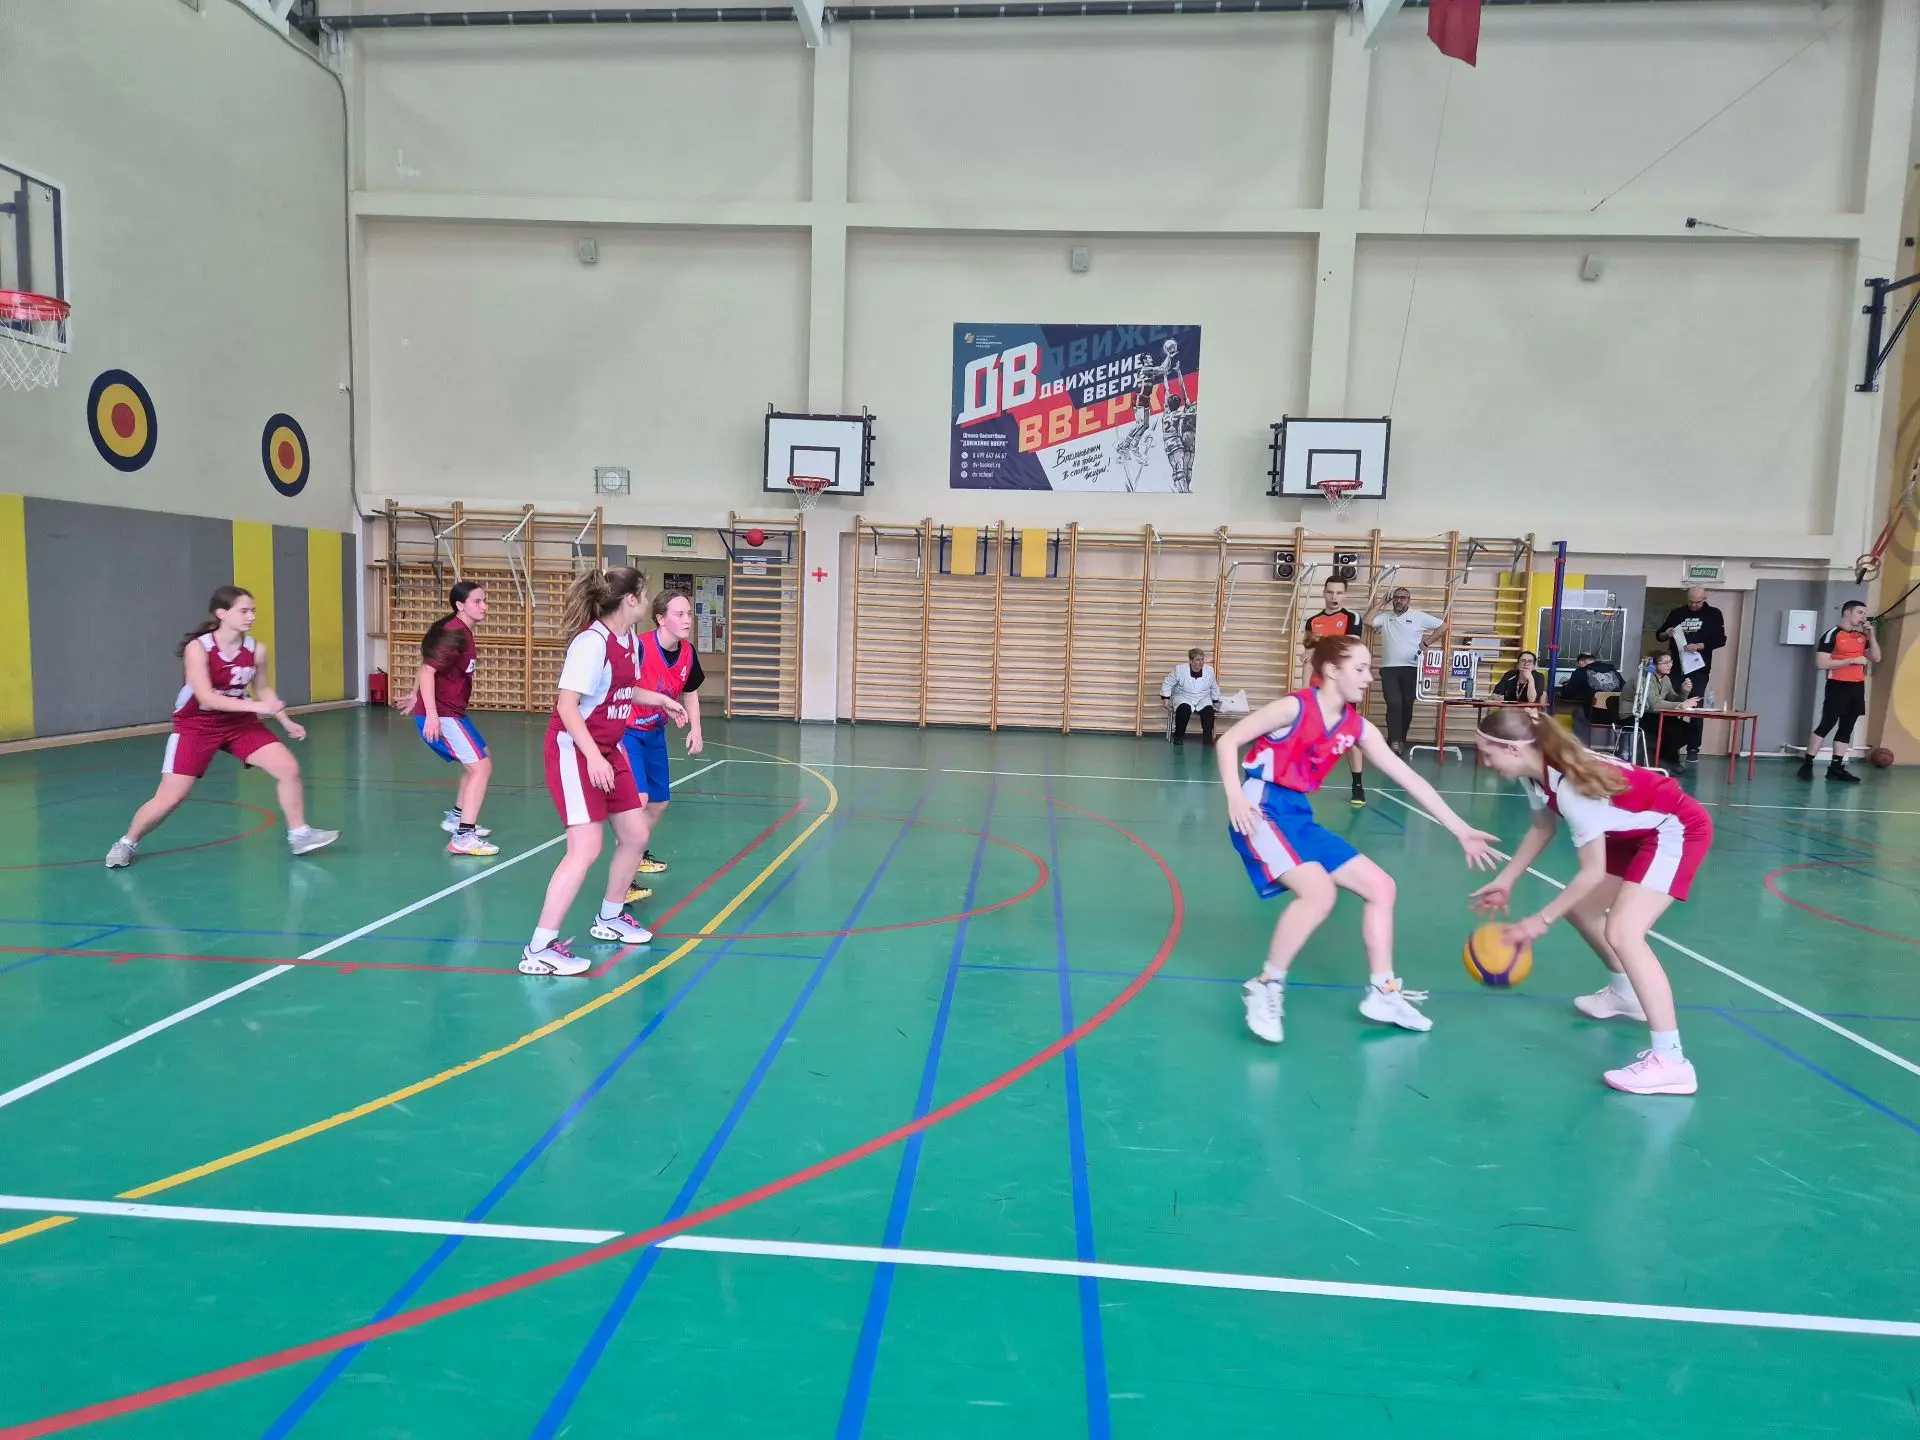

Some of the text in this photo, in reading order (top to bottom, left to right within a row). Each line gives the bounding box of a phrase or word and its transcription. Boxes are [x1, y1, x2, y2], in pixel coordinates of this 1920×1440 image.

[956, 341, 1038, 425] ДВ
[1039, 353, 1144, 399] ДВИЖЕНИЕ
[1454, 655, 1469, 668] 00
[680, 666, 687, 682] 4
[1425, 680, 1430, 689] 0
